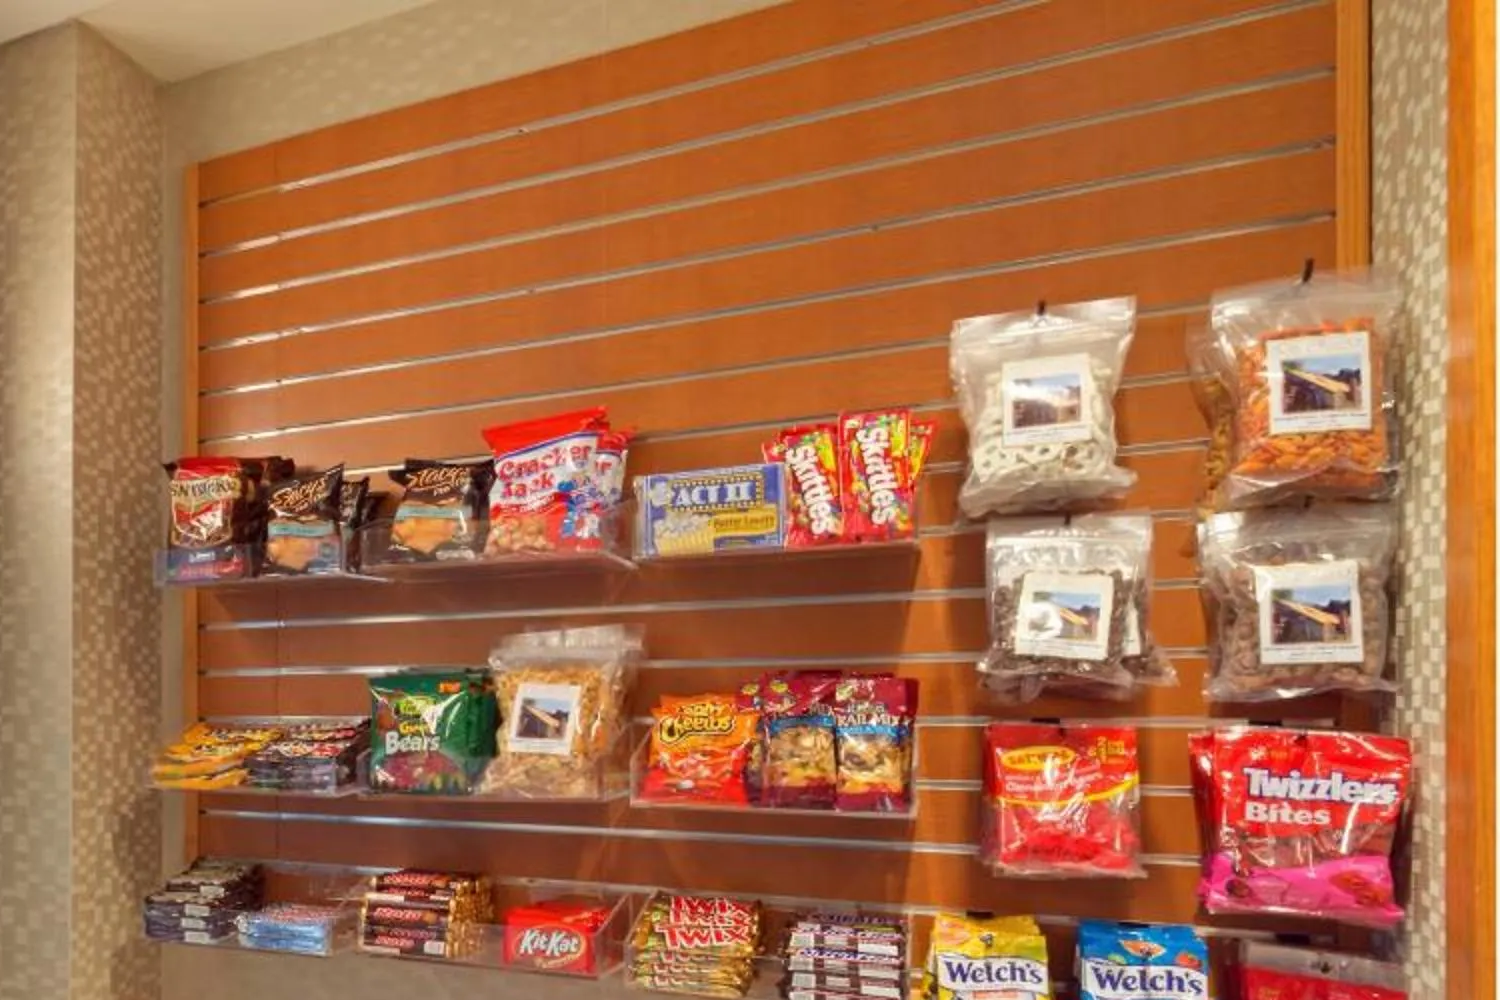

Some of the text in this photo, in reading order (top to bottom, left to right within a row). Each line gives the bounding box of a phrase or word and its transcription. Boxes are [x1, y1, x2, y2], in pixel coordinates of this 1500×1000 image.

[500, 444, 592, 480] Cracker
[855, 427, 899, 525] Skittles
[674, 481, 753, 507] ACT II
[785, 444, 841, 535] Skittles
[385, 731, 441, 755] Bears
[659, 714, 734, 744] Cheetos
[1243, 766, 1397, 806] Twizzlers
[1244, 801, 1331, 825] Bites
[943, 960, 1044, 984] Welch's
[1091, 965, 1204, 995] Welch's
